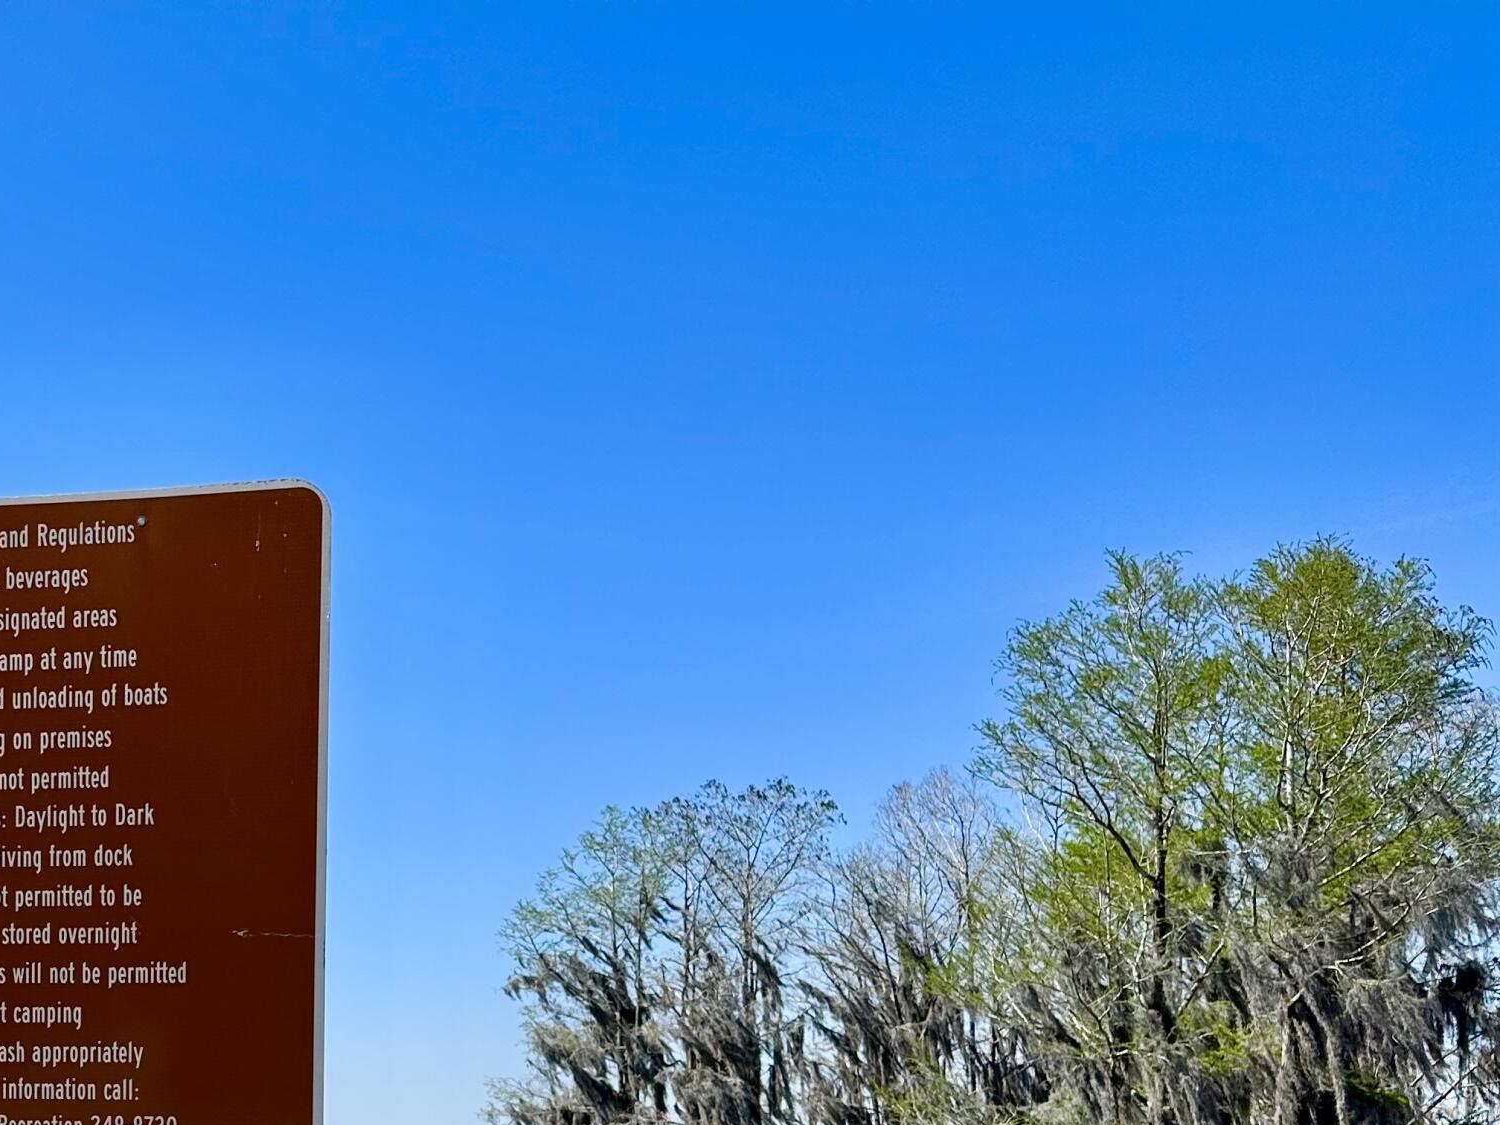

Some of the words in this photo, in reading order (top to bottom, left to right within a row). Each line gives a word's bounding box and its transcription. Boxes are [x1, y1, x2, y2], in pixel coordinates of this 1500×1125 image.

[0, 525, 28, 548] and
[38, 521, 134, 552] Regulations
[7, 567, 88, 594] beverages
[73, 609, 116, 628] areas
[41, 648, 56, 670] at
[63, 652, 93, 674] any
[100, 645, 136, 667] time
[13, 685, 93, 714] unloading
[102, 684, 116, 706] of
[125, 682, 167, 705] boats
[14, 733, 31, 749] on
[41, 725, 111, 754] premises
[0, 768, 24, 790] not
[32, 766, 108, 794] permitted
[16, 805, 85, 833] Daylight
[91, 805, 106, 826] to
[116, 803, 154, 825] Dark
[50, 845, 86, 866] from
[95, 844, 132, 866] dock
[16, 885, 92, 912] permitted
[100, 885, 115, 906] to
[124, 884, 141, 905] be
[2, 923, 50, 944] stored
[59, 922, 137, 950] overnight
[13, 962, 41, 983] will
[50, 962, 75, 983] not
[83, 962, 100, 983] be
[109, 962, 186, 988] permitted
[14, 1002, 81, 1030] camping
[32, 1041, 143, 1068] appropriately
[3, 1078, 95, 1099] information
[104, 1079, 138, 1100] call:
